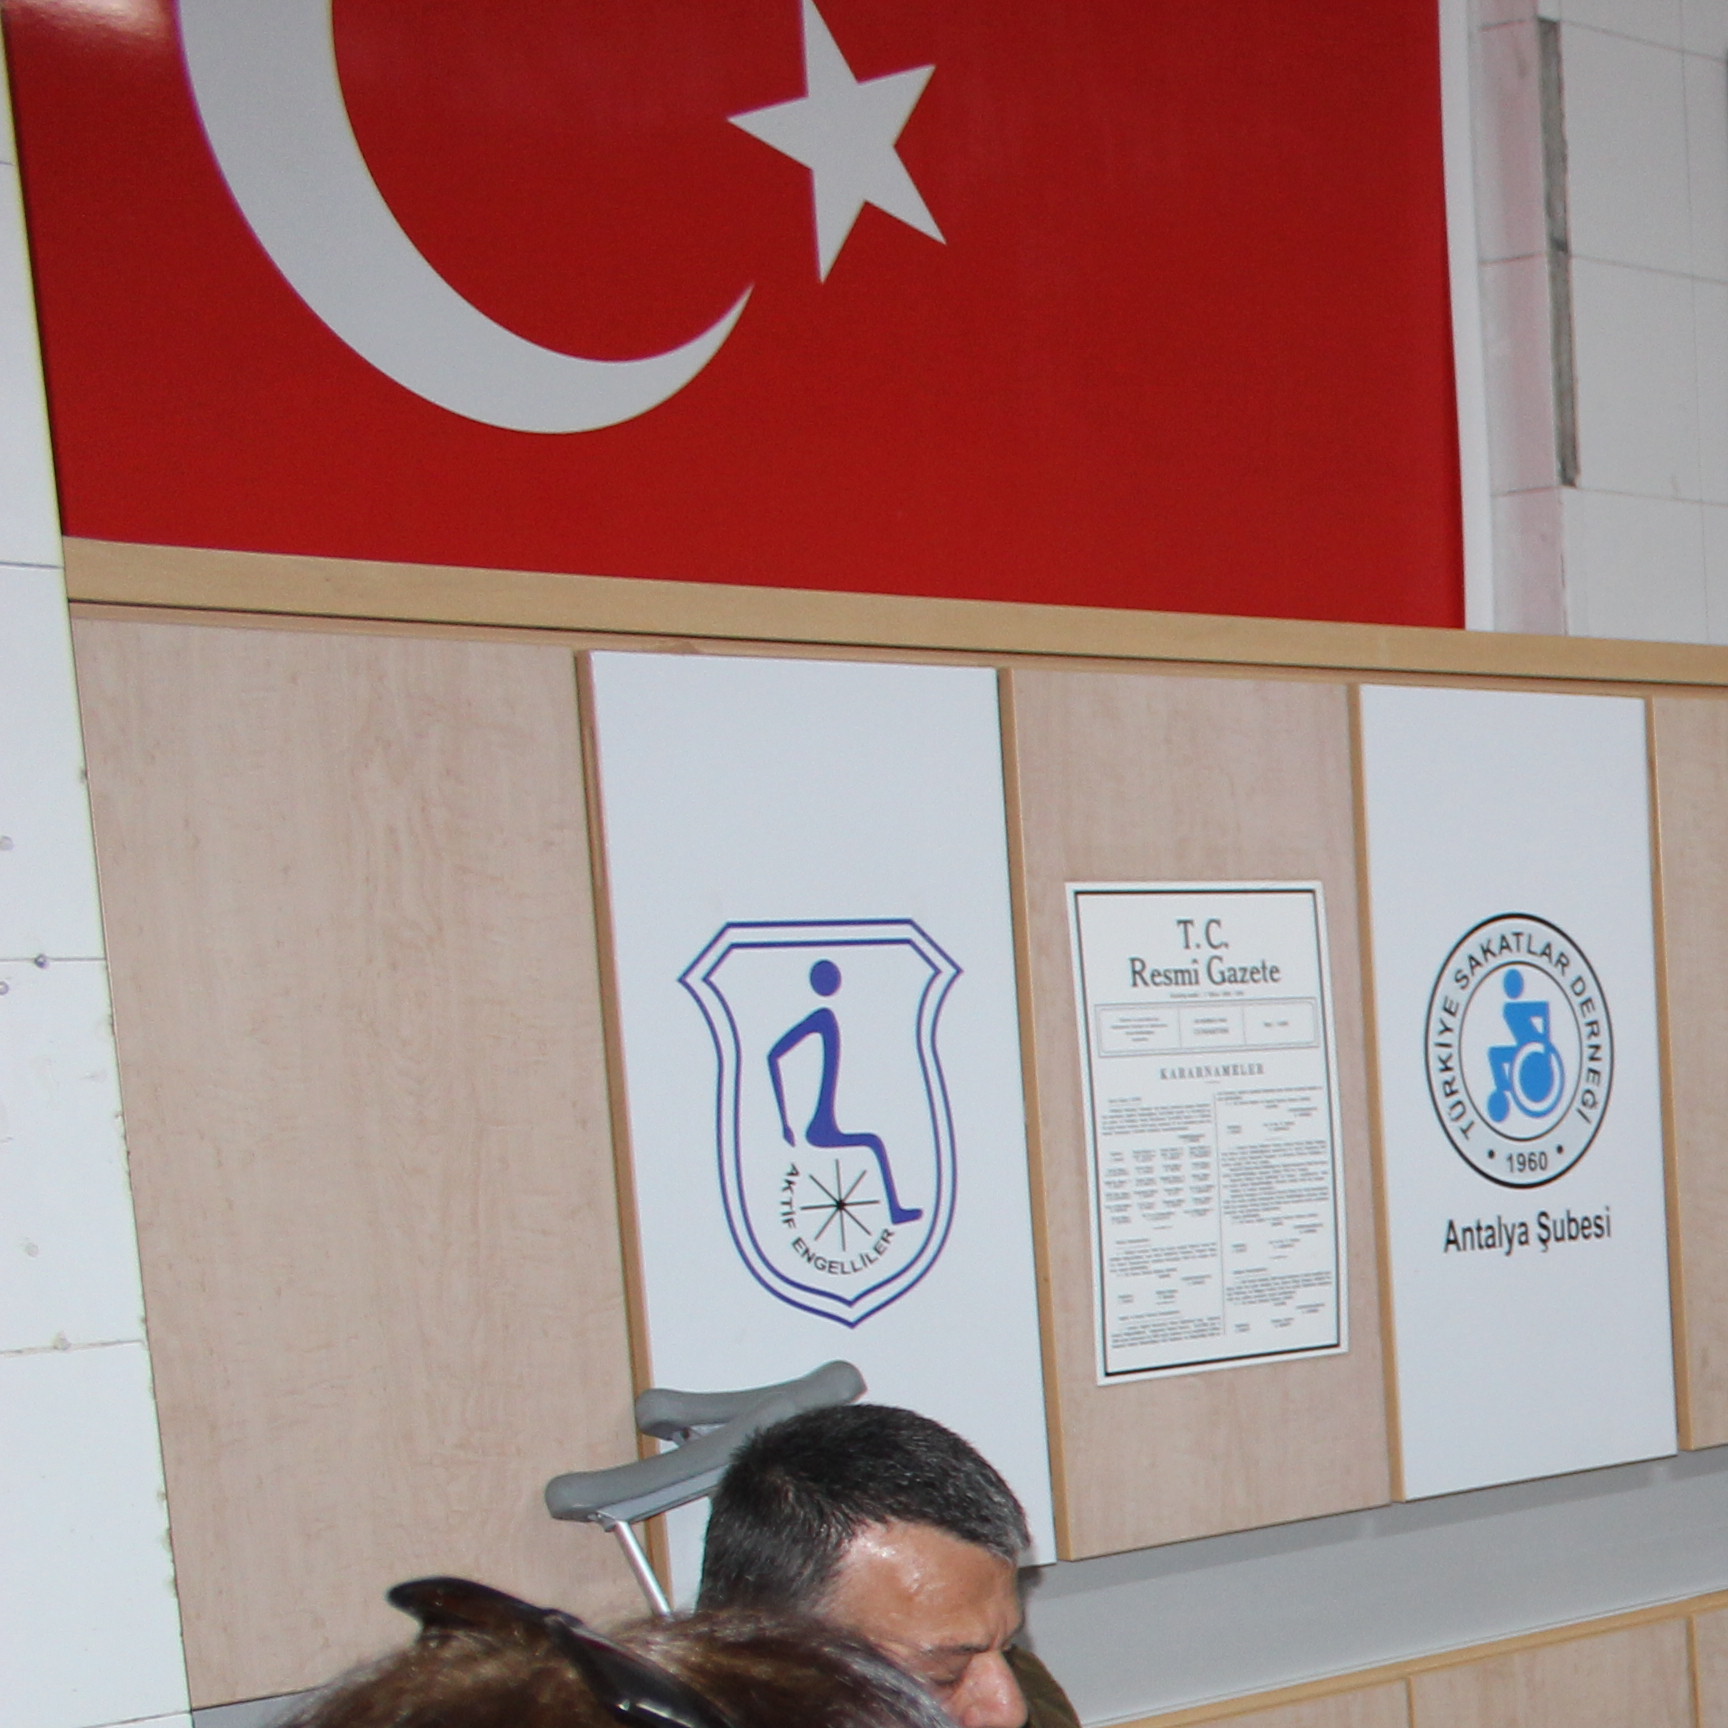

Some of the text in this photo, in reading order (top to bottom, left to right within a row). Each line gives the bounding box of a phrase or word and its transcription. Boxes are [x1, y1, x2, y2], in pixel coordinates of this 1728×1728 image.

[1206, 955, 1282, 986] Gazete
[1433, 932, 1603, 1141] TÜRKİYE SAKATLAR DERNEĞİ
[1505, 1151, 1549, 1174] 1960
[1444, 1205, 1612, 1256] Antalya Şubesi
